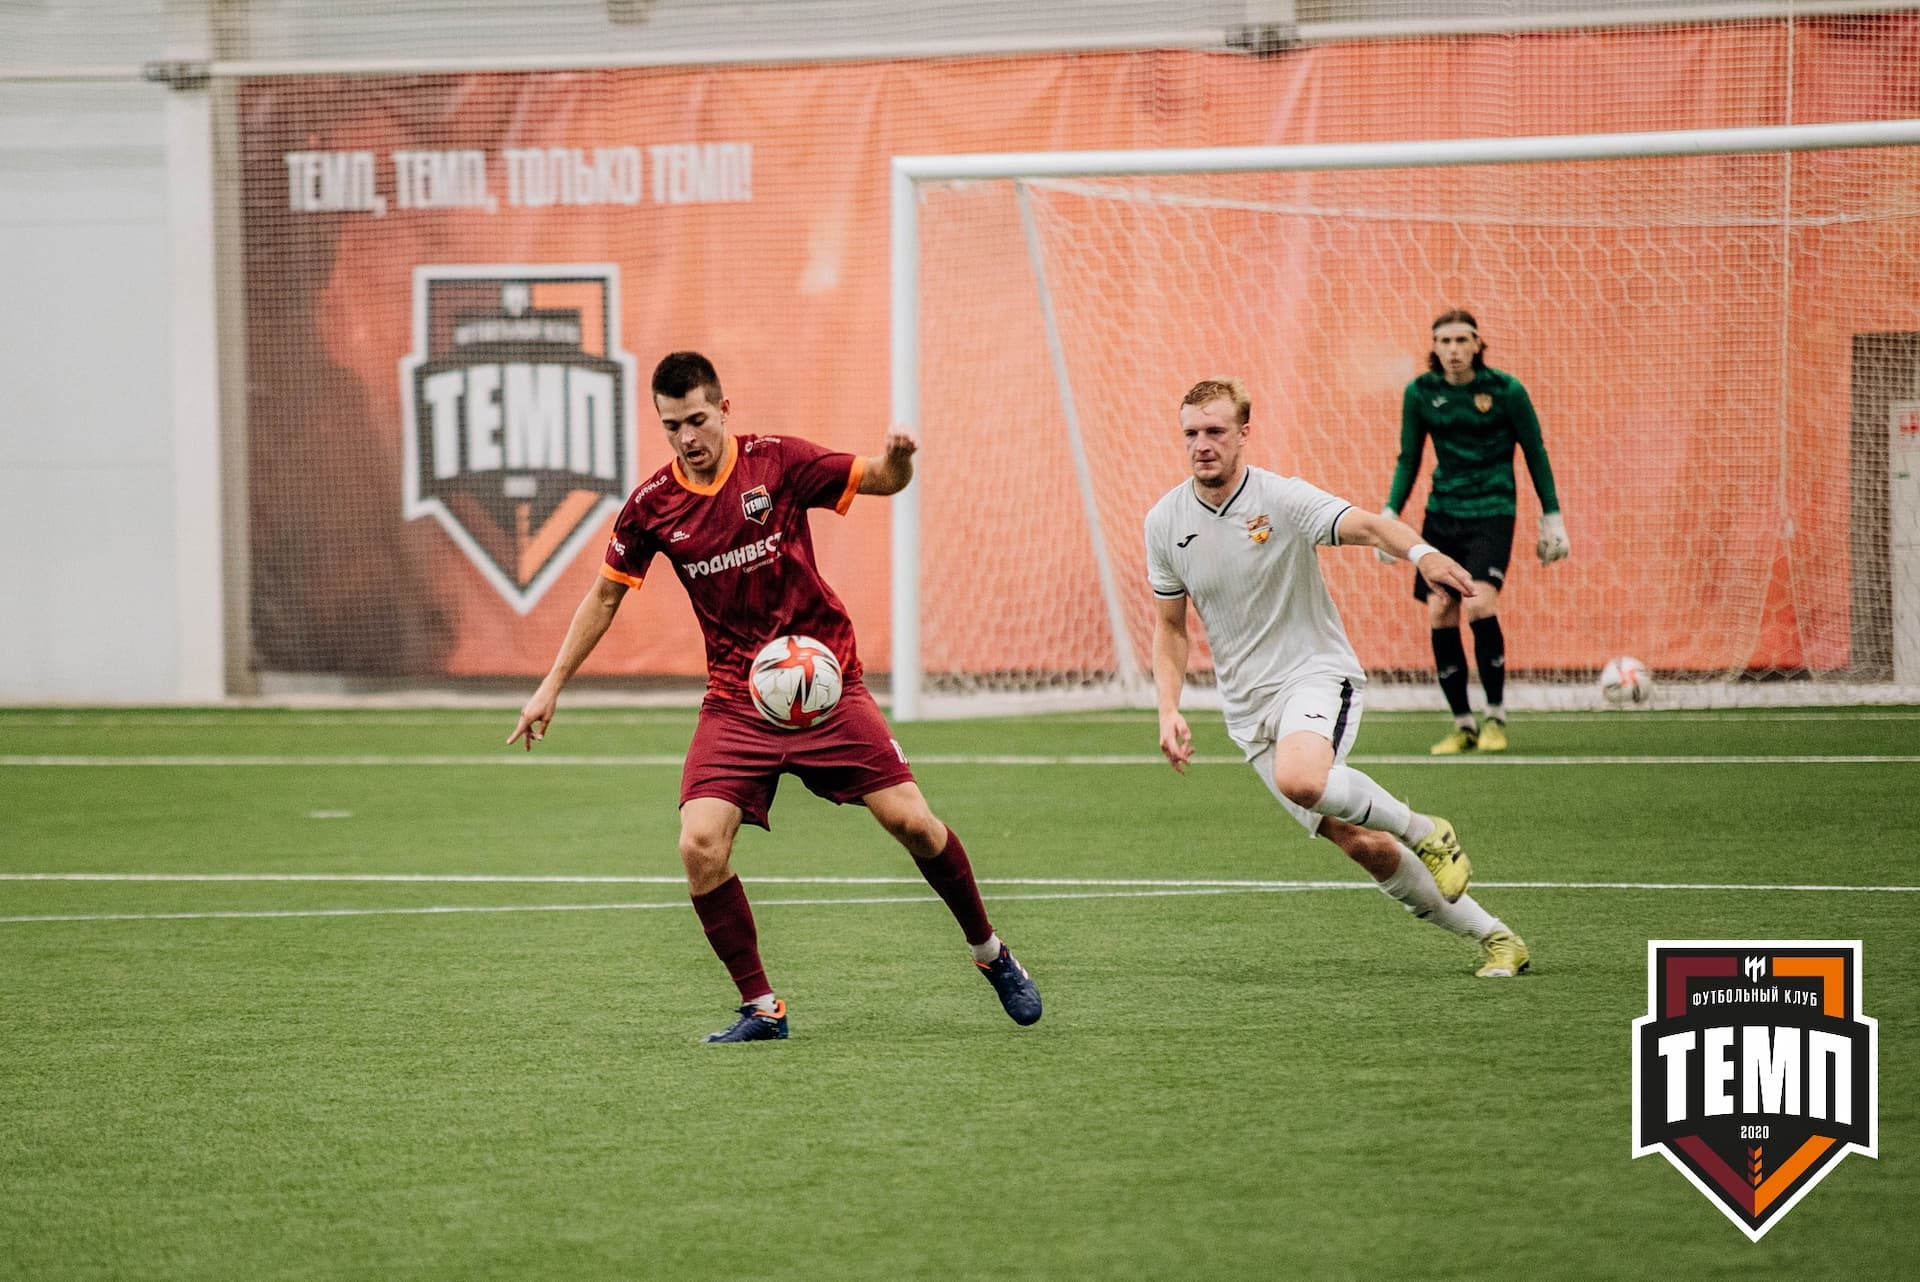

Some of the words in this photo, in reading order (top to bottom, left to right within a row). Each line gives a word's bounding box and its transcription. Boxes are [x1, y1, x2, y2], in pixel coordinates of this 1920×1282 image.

[286, 150, 387, 217] ТЕМП,
[394, 149, 498, 213] ТЕМП,
[503, 146, 642, 206] ТОЛЬКО
[648, 142, 753, 201] ТЕМП!
[423, 362, 617, 480] ТЕМП
[745, 496, 770, 515] ТЕМП
[682, 532, 782, 579] РОДИНВЕС
